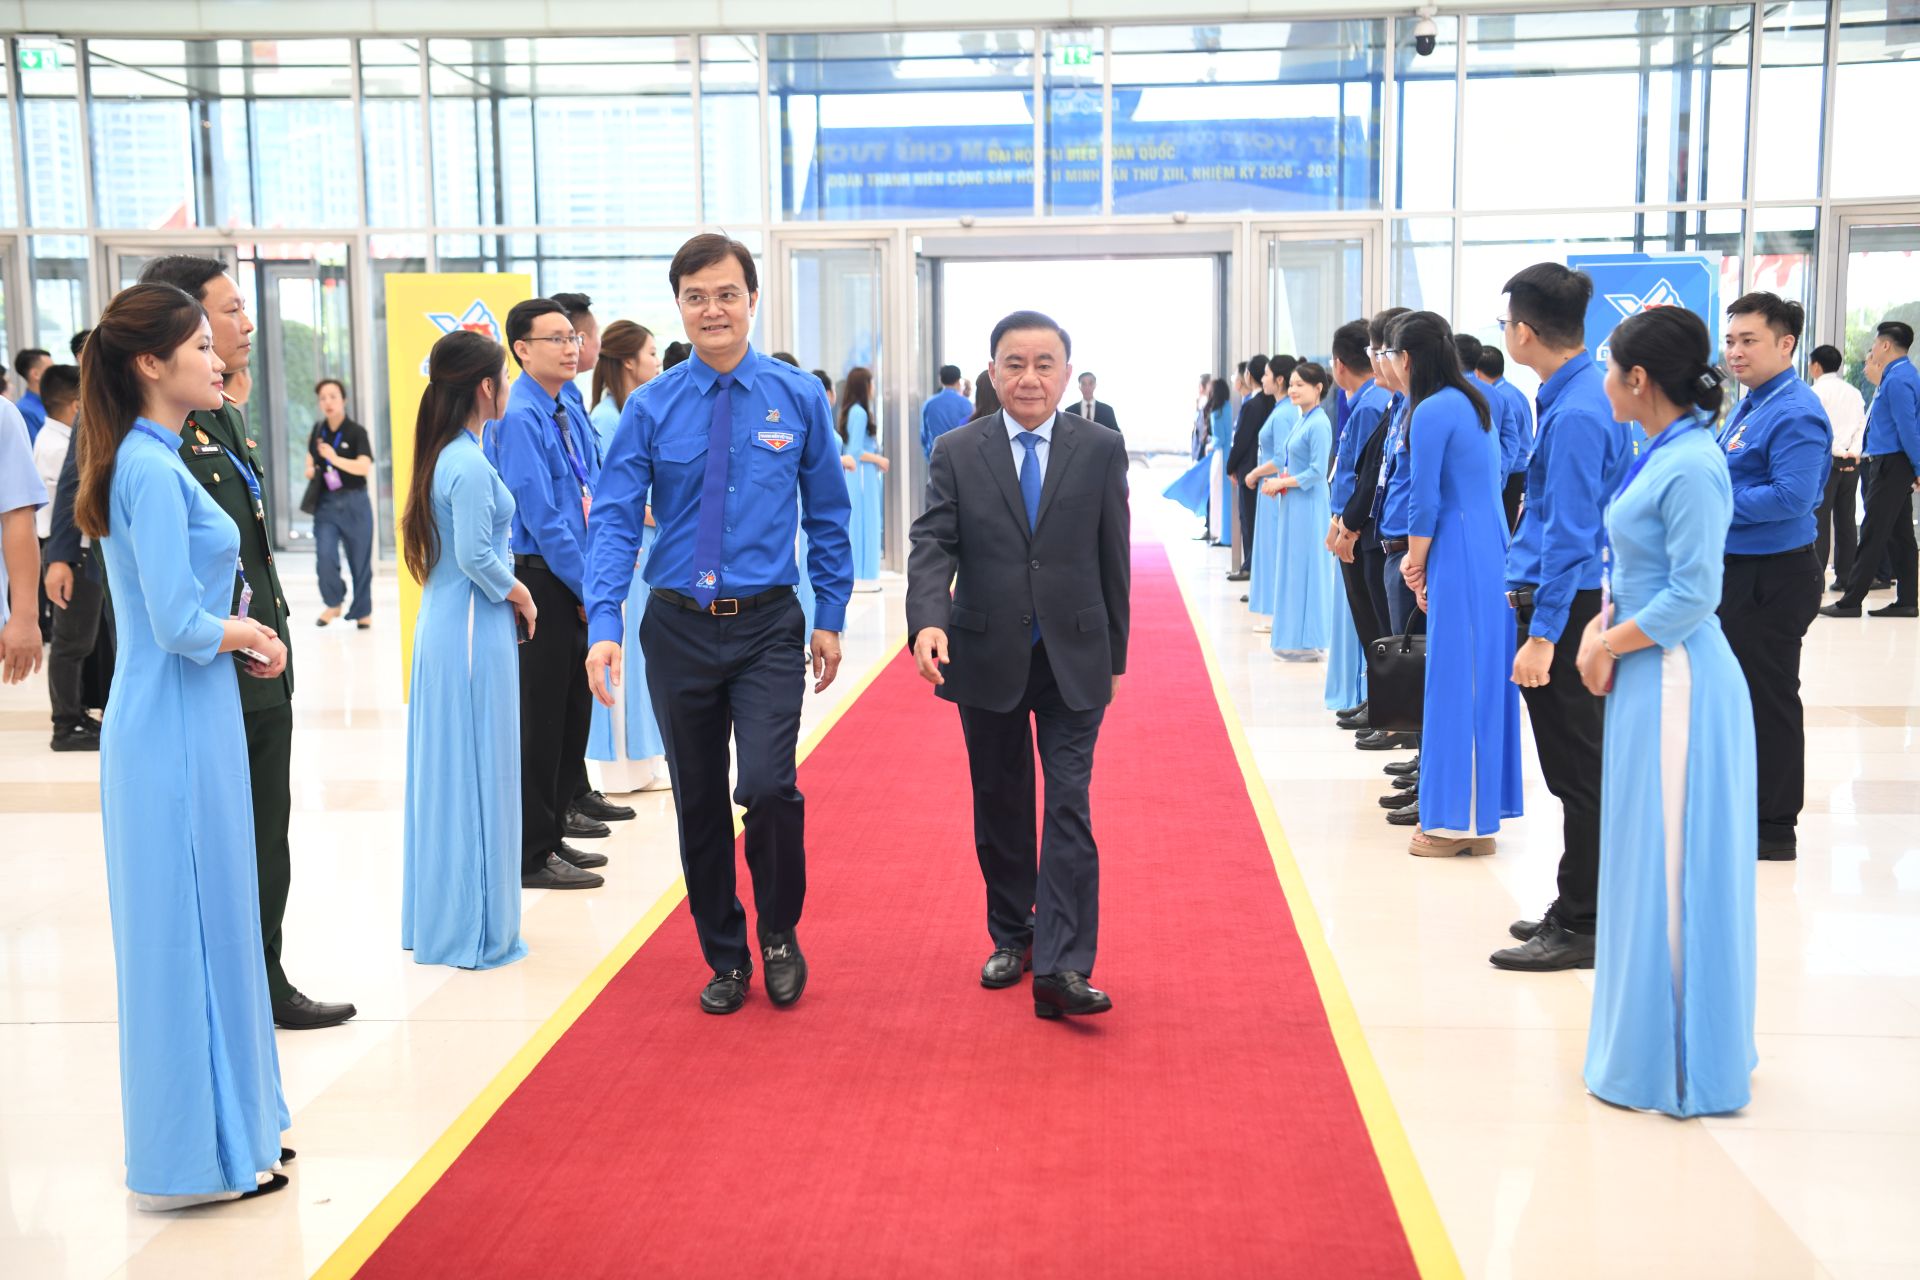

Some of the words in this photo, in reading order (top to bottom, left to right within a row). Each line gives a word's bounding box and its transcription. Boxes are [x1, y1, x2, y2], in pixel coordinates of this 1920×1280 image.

[1014, 144, 1035, 165] HỘ
[1139, 141, 1176, 160] QUỐC
[1260, 164, 1293, 180] 2026
